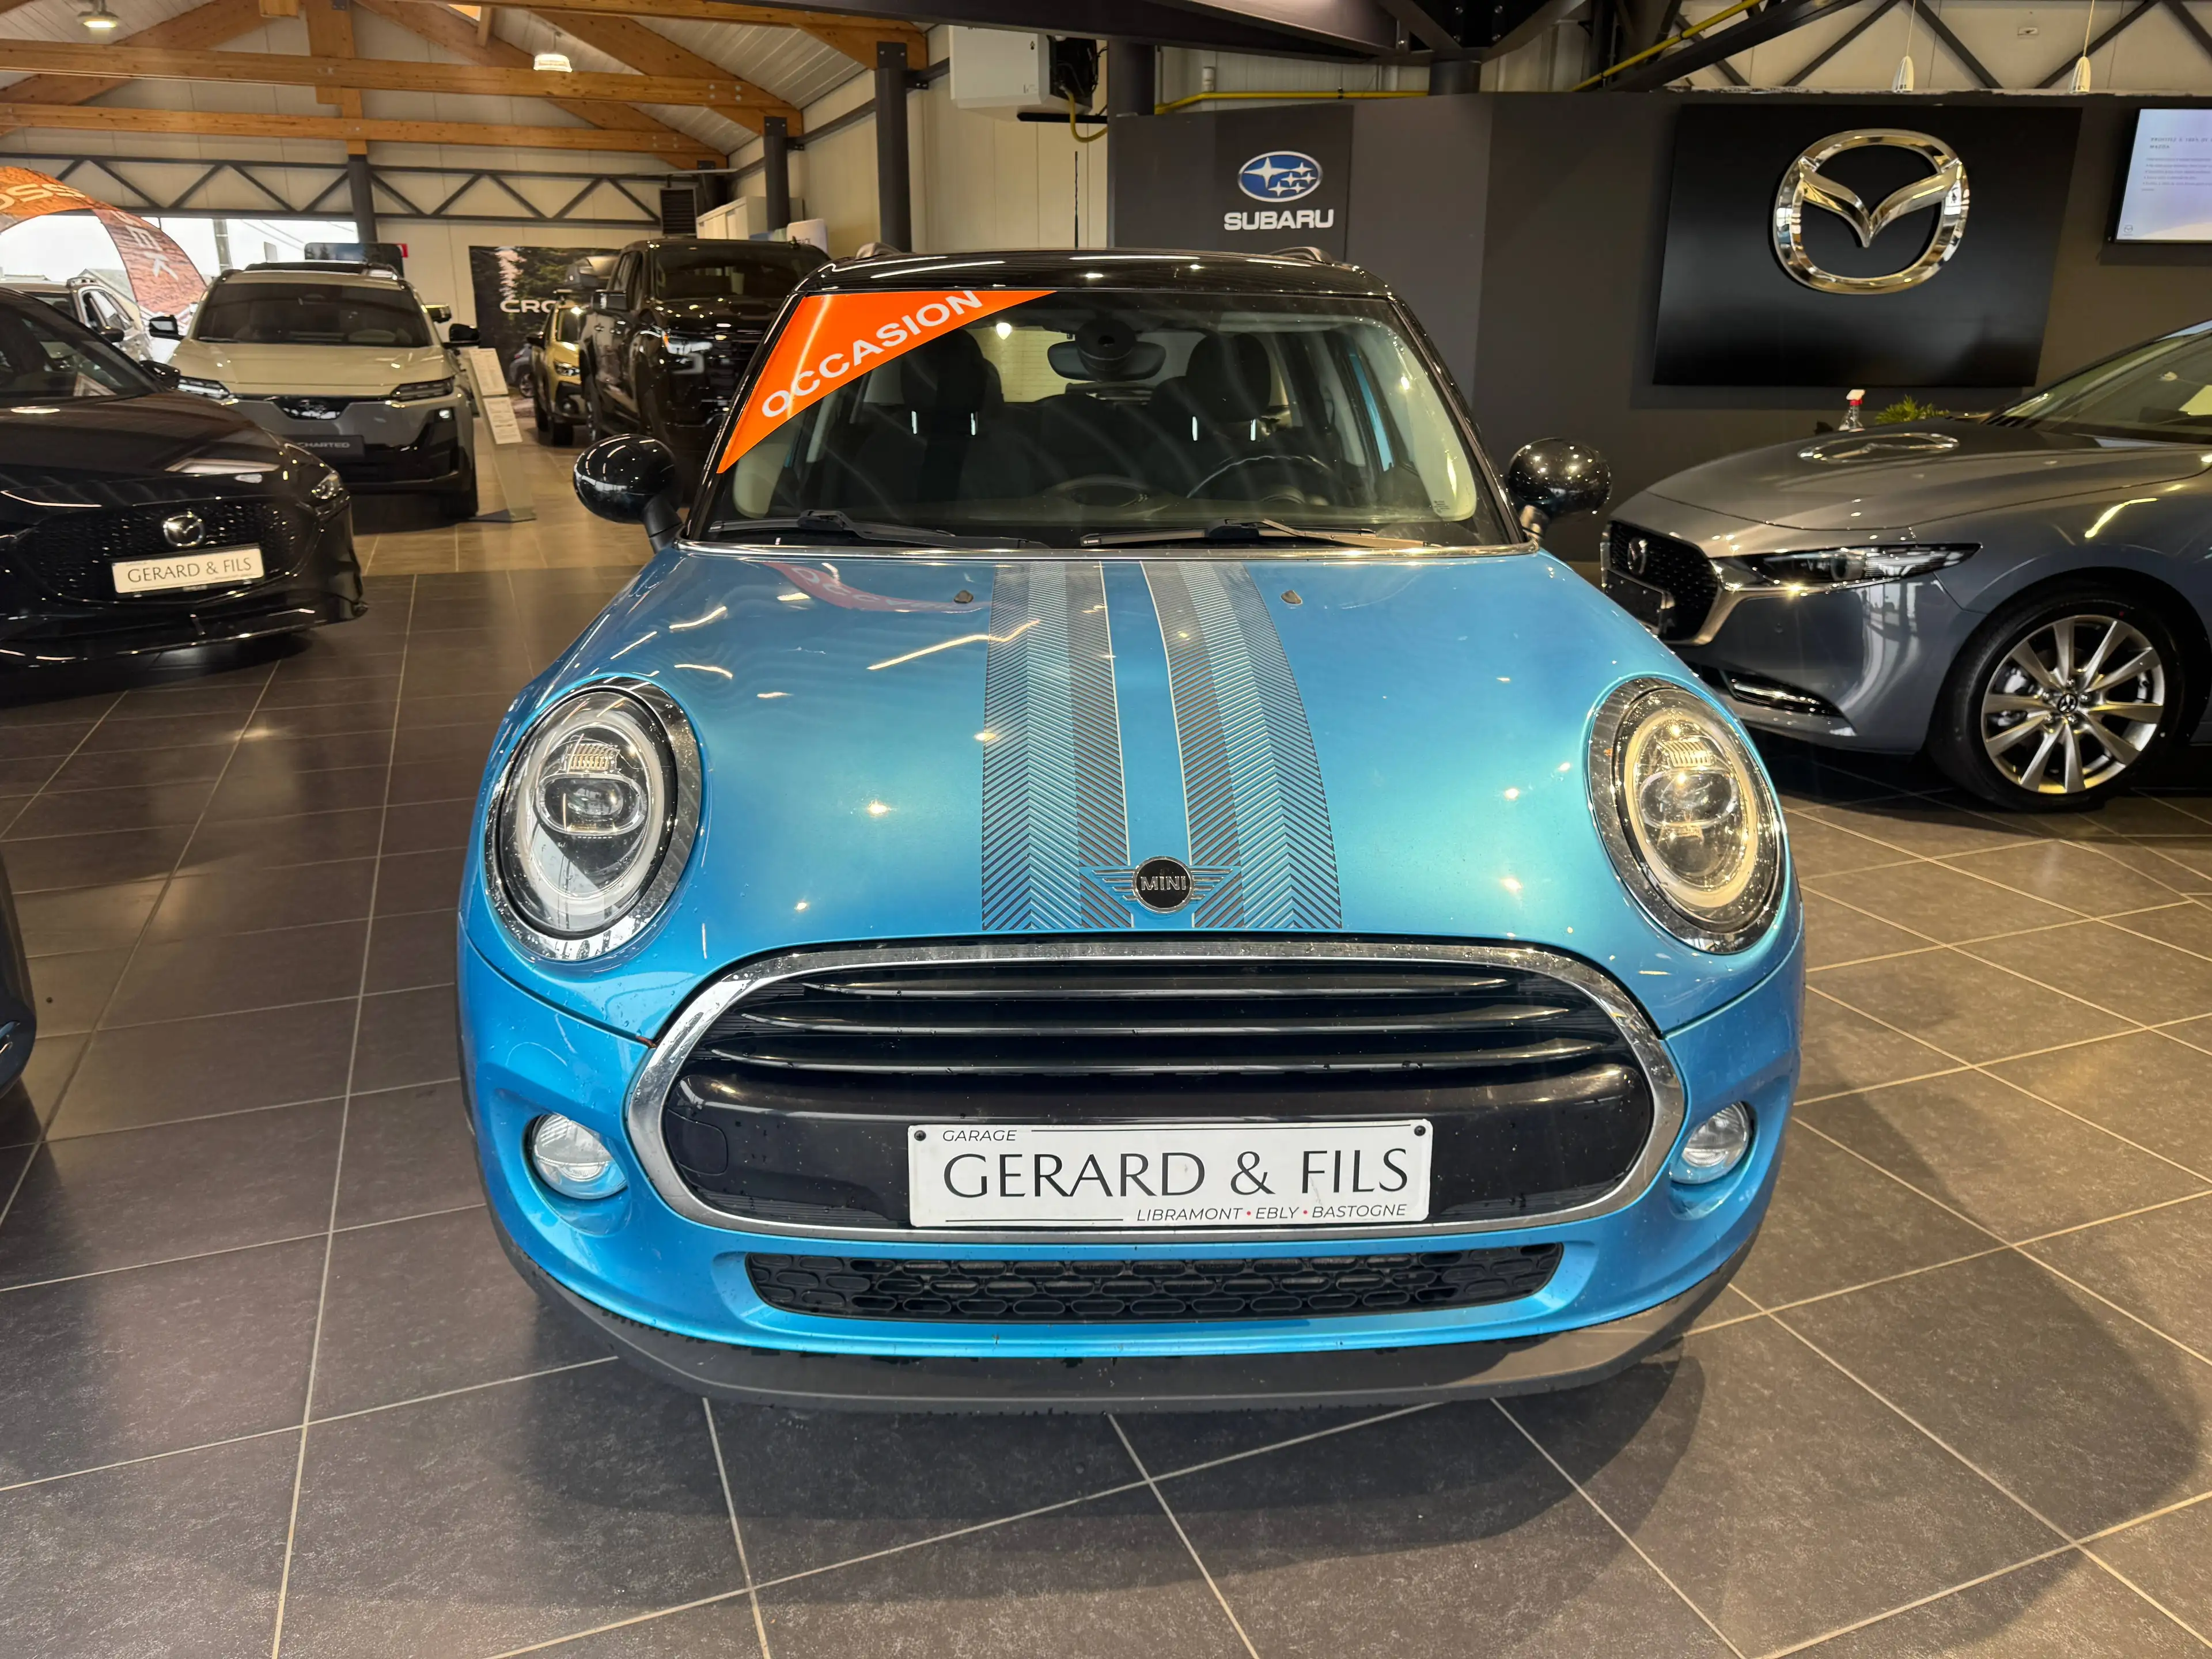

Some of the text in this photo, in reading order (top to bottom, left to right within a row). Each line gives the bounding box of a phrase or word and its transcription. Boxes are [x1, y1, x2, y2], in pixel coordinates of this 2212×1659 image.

[1224, 209, 1335, 230] SUBARU
[762, 290, 983, 417] OCCASION
[128, 563, 200, 582] GERARD
[206, 561, 218, 574] &
[223, 558, 251, 573] FILS
[1140, 876, 1187, 891] MINI
[942, 1130, 1017, 1142] GARAGE
[944, 1147, 1408, 1198] GERARD & FILS
[1137, 1203, 1407, 1221] LIBRAMONT EBLY BASTOGNE
